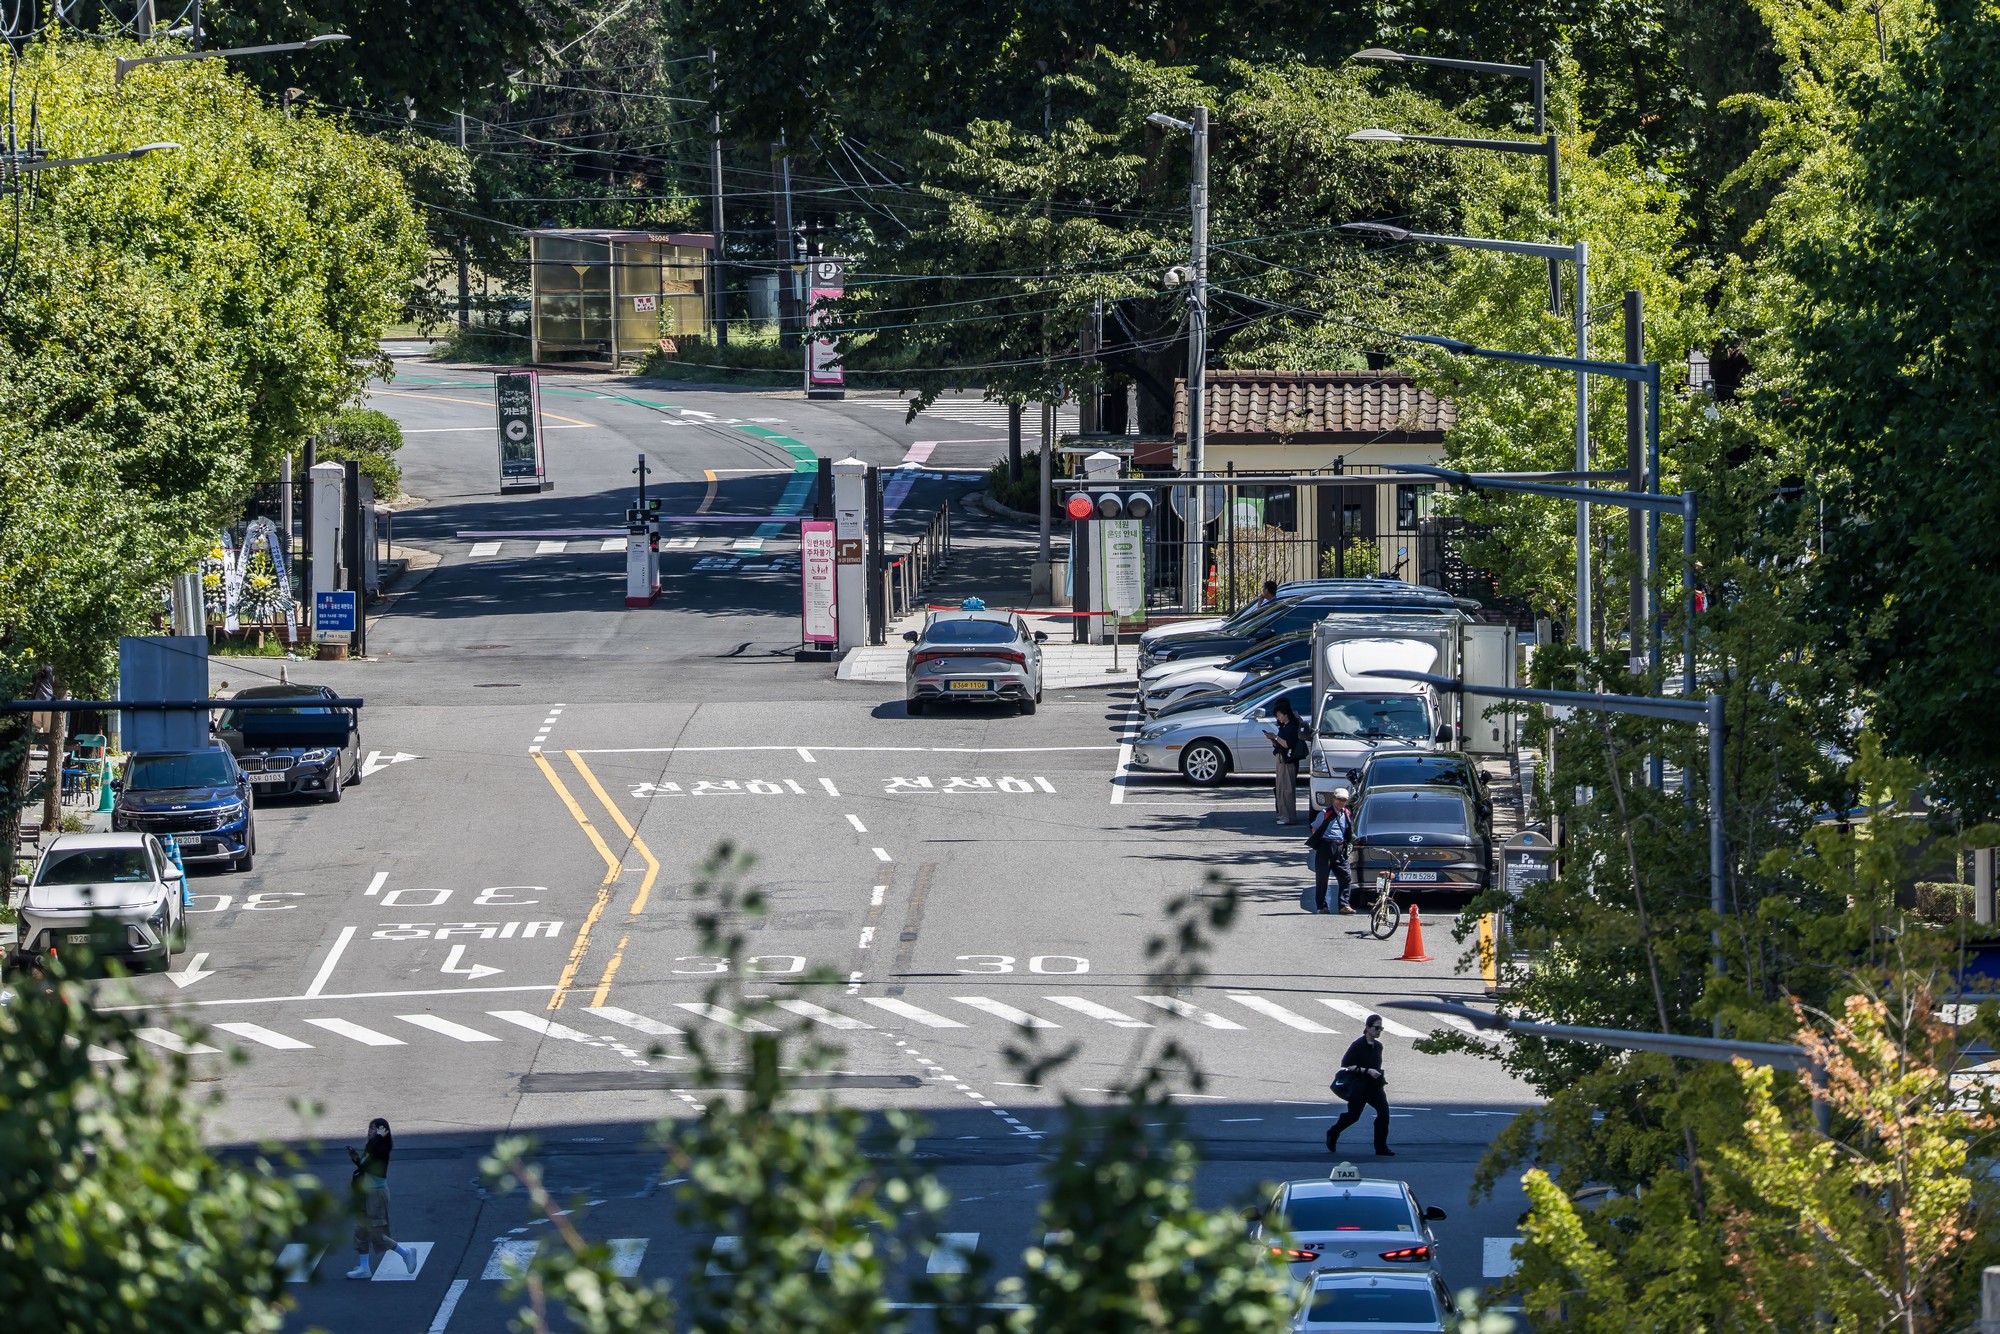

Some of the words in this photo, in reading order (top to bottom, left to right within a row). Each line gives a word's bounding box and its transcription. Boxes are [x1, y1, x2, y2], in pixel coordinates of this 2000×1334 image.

[503, 406, 528, 416] 가는길
[1107, 530, 1121, 539] 운영
[1123, 529, 1138, 539] 안내
[806, 539, 831, 548] 일반차량
[806, 548, 831, 557] 주차불가
[628, 778, 807, 798] 천천히
[882, 775, 1057, 794] 천천히
[183, 836, 200, 844] 2018
[1418, 872, 1436, 880] 5286
[380, 886, 548, 907] 30
[370, 921, 565, 941] 비보호
[955, 954, 1091, 975] 30
